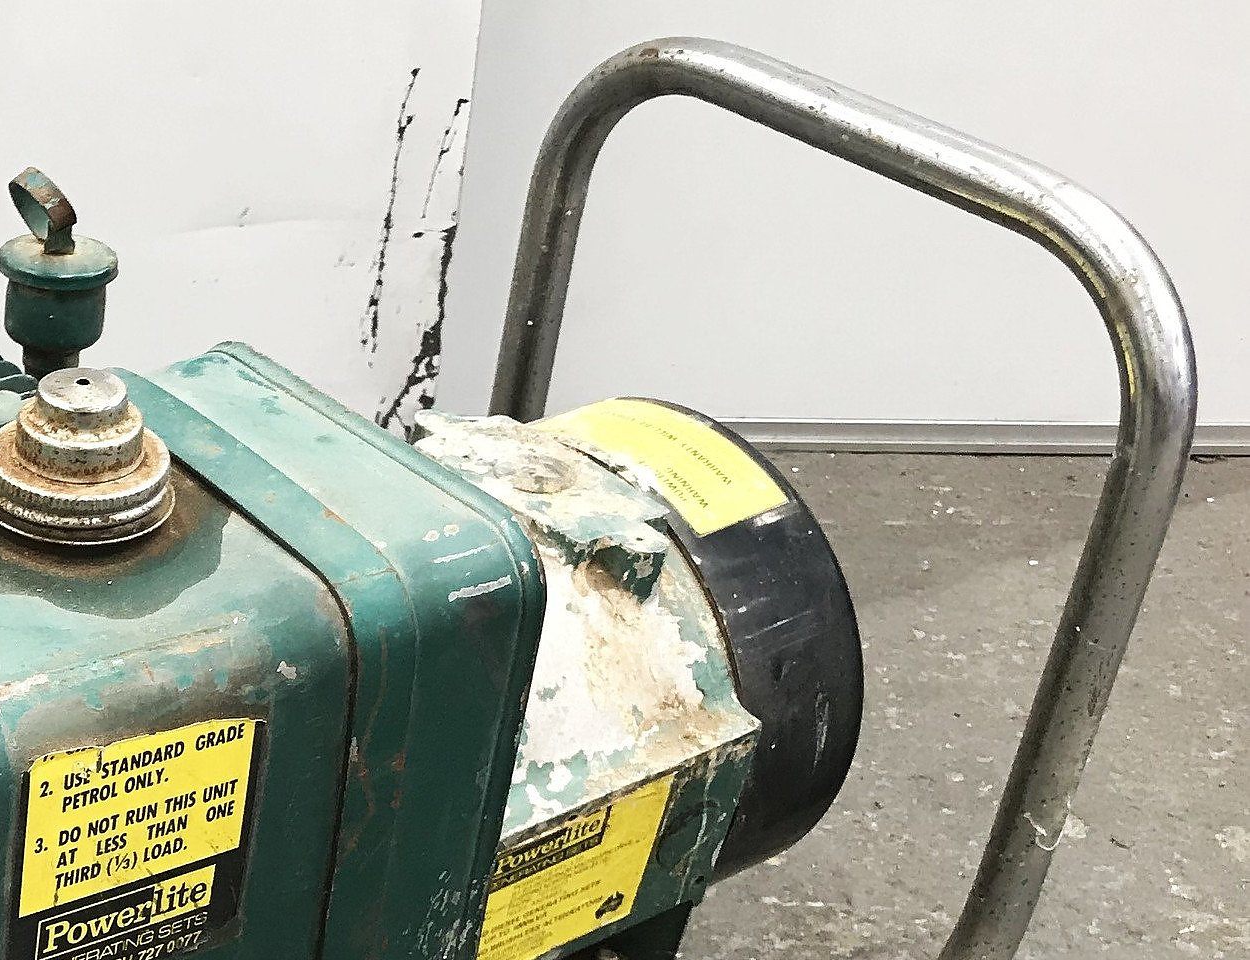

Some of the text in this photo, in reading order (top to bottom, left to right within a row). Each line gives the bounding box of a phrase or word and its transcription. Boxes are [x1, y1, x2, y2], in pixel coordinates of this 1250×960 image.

[39, 722, 246, 798] 2. USE STANDARD GRADE
[62, 768, 169, 813] PETROL ONLY.
[35, 779, 239, 854] 3. DO NOT RUN THIS UNIT
[56, 800, 235, 869] AT LESS THAN ONE
[494, 819, 601, 876] Powerlite
[55, 862, 101, 890] THIRD
[143, 837, 187, 863] LOAD.
[43, 880, 207, 954] Powerlite
[158, 911, 208, 941] SETS
